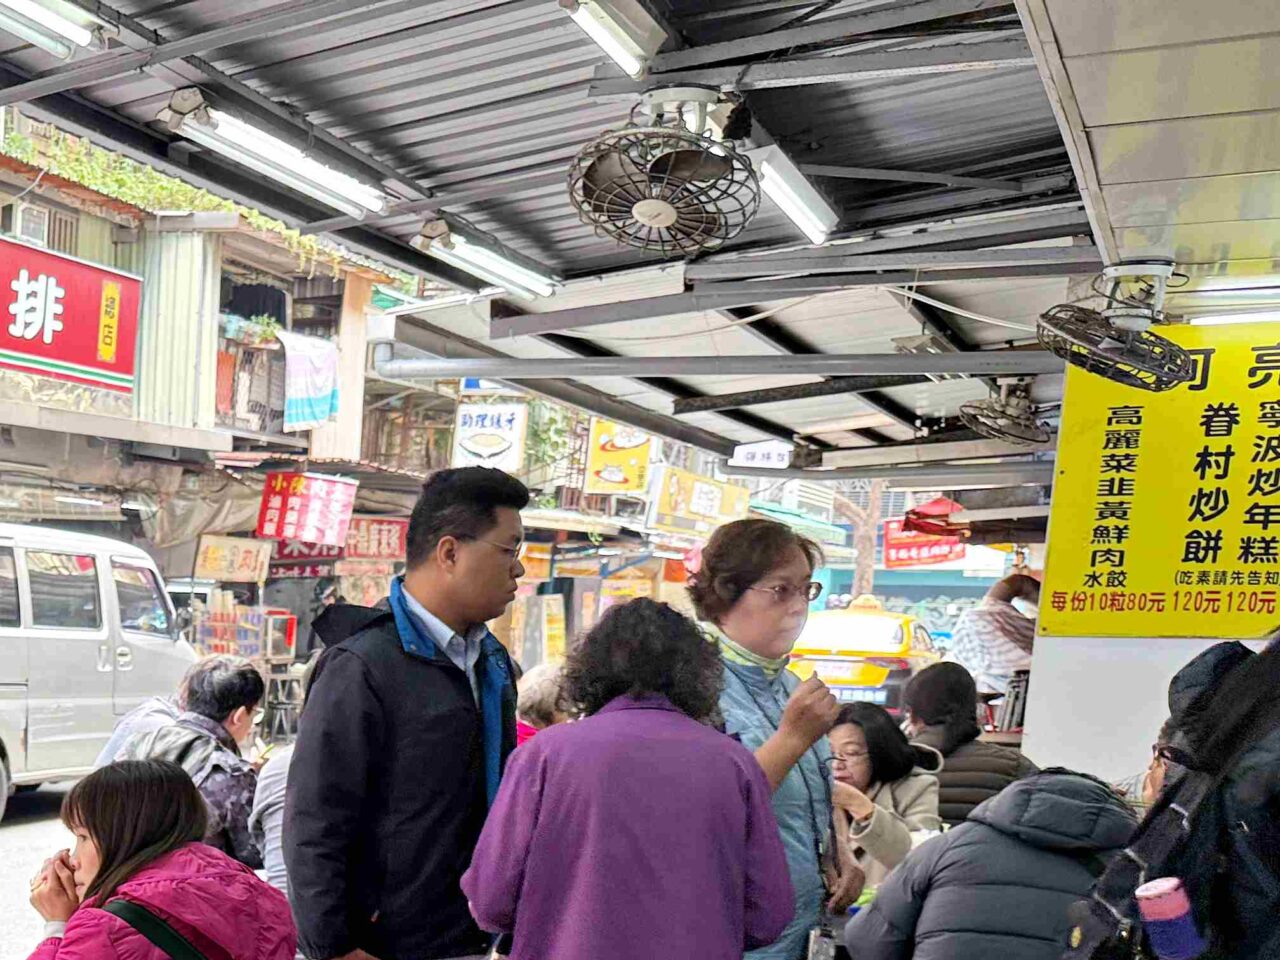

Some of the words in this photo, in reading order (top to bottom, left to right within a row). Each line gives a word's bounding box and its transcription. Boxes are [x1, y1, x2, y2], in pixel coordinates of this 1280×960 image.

[1181, 401, 1241, 565] 眷村炒餅
[1174, 570, 1280, 587] (吃素請先告知
[1173, 590, 1221, 614] 120元
[1227, 590, 1277, 614] 120元
